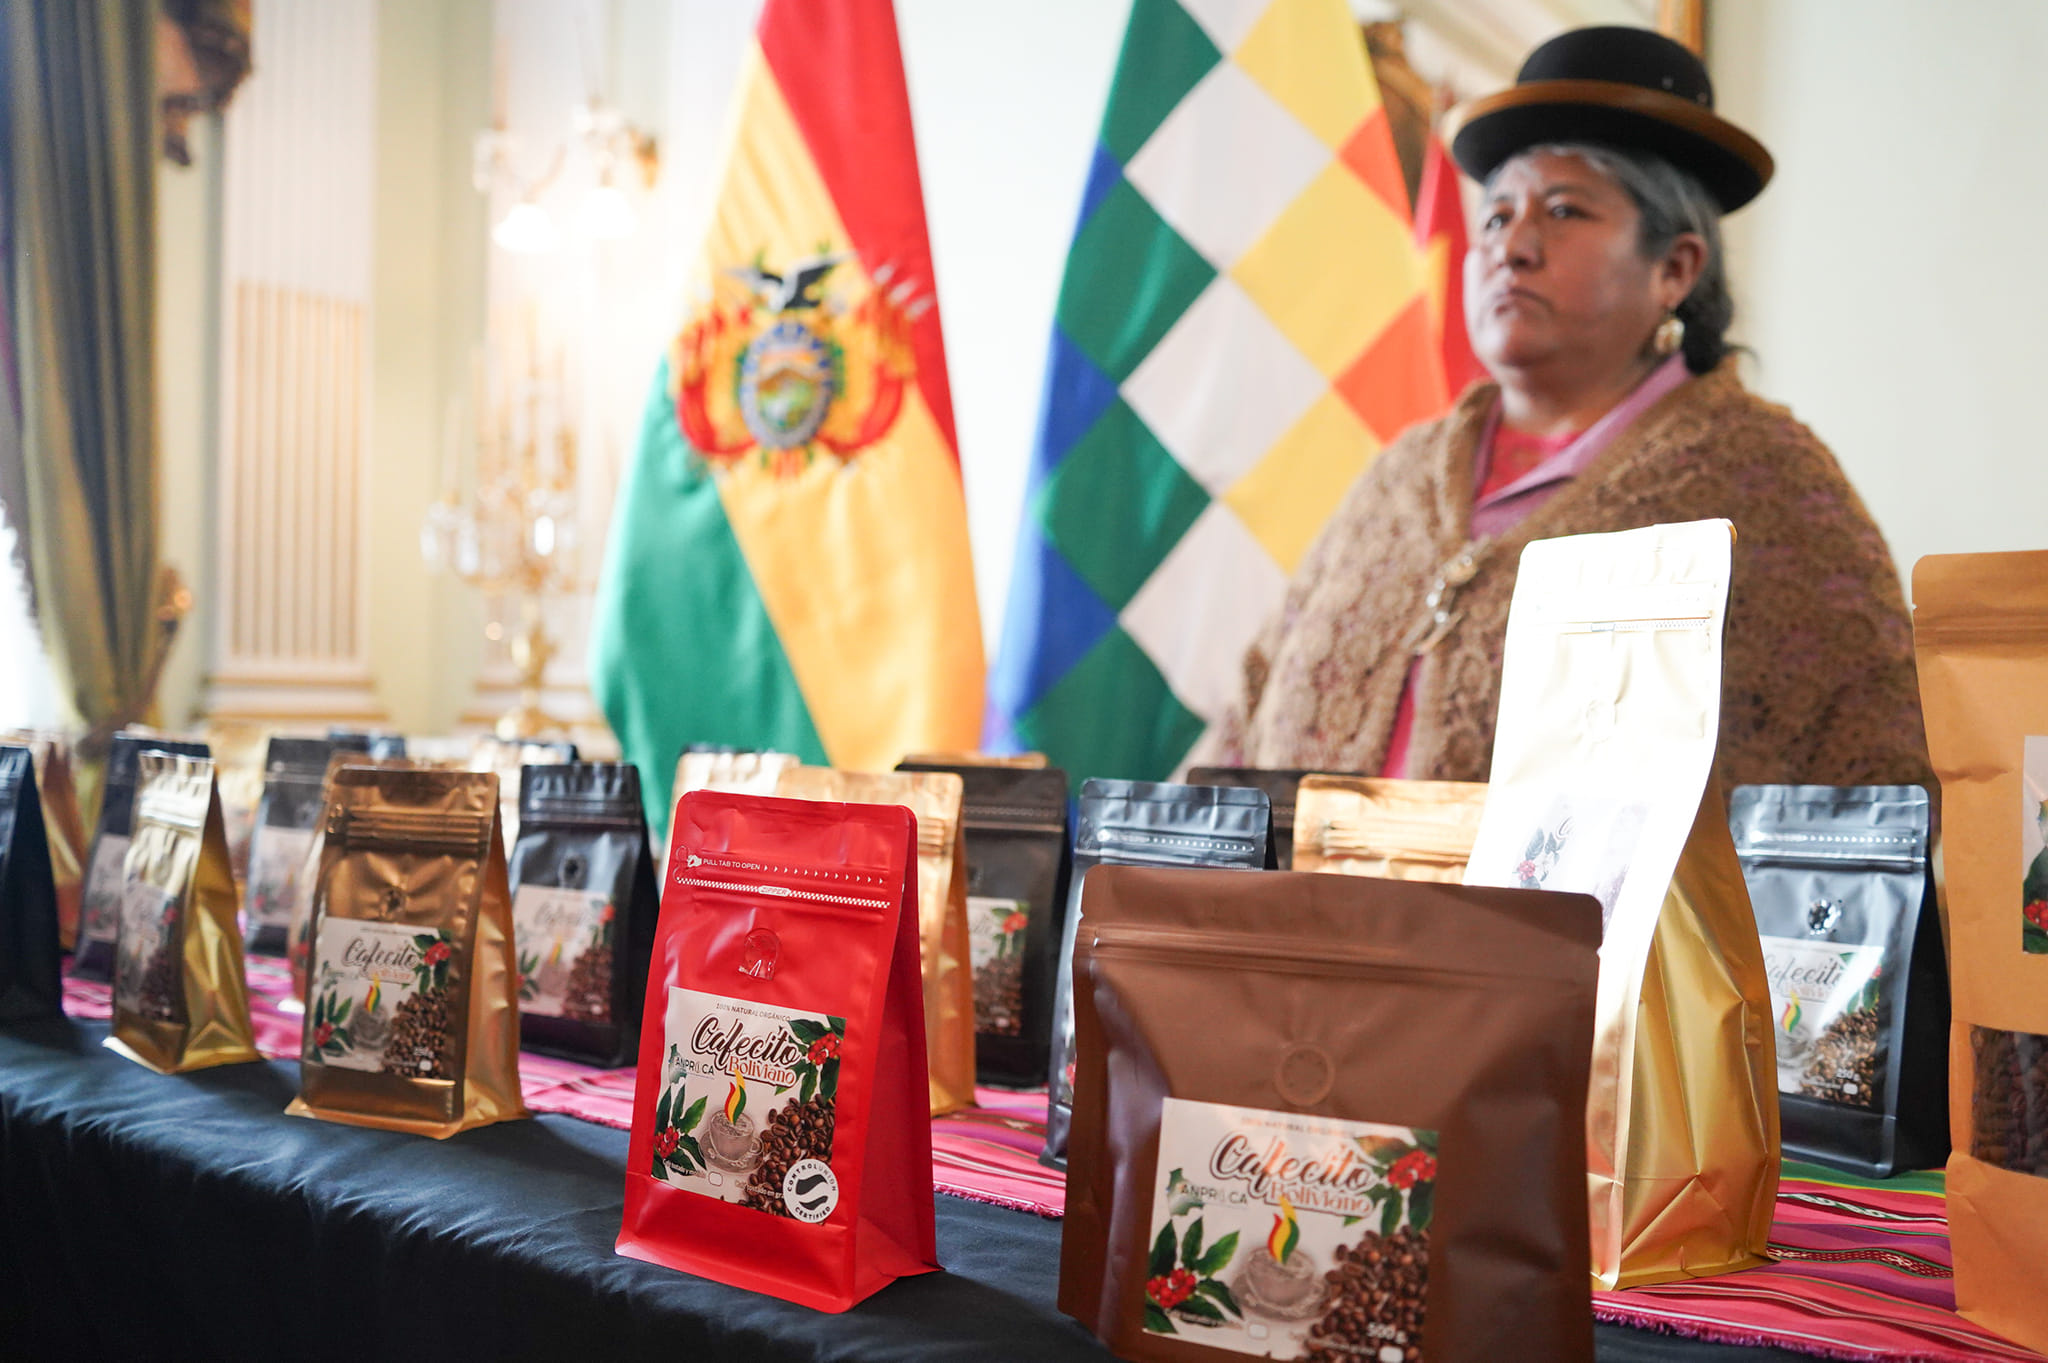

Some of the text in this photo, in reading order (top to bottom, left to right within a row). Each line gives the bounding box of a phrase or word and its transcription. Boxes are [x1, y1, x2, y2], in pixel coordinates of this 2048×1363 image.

[703, 858, 718, 866] PULL
[741, 862, 760, 870] OPEN
[731, 1006, 759, 1017] NATURAL
[692, 1014, 802, 1069] Cafecito
[728, 1055, 795, 1085] Boliviano
[1211, 1130, 1375, 1199] Cafecito
[795, 1206, 831, 1220] CERTIFIED
